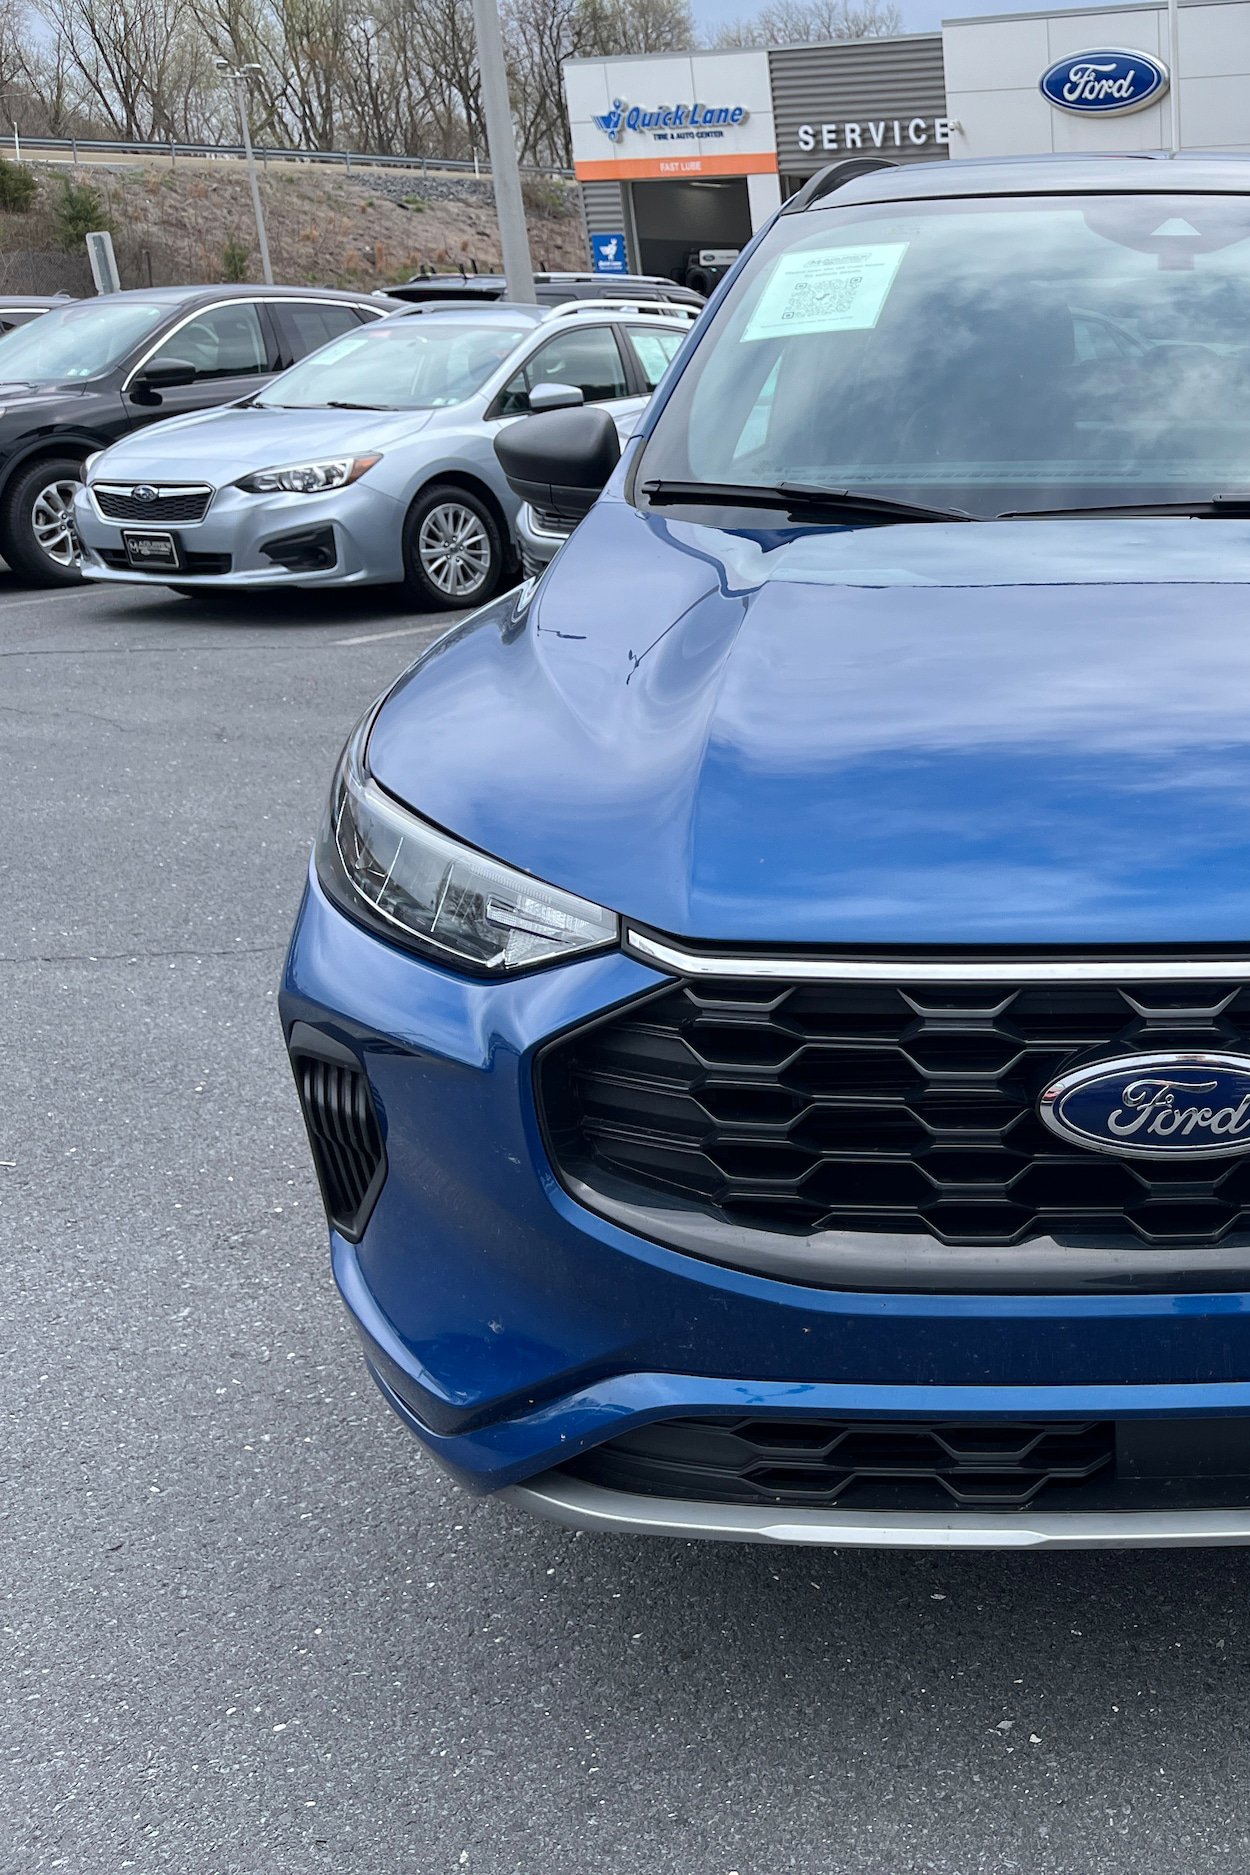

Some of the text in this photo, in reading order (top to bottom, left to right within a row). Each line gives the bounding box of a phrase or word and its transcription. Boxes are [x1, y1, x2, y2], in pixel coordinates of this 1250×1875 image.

[1063, 62, 1135, 101] Ford
[626, 103, 744, 131] Quick Lane
[676, 131, 695, 140] AUTO
[695, 130, 724, 139] CENTER
[798, 118, 949, 151] SERVICE
[660, 160, 702, 173] FAST LUBE
